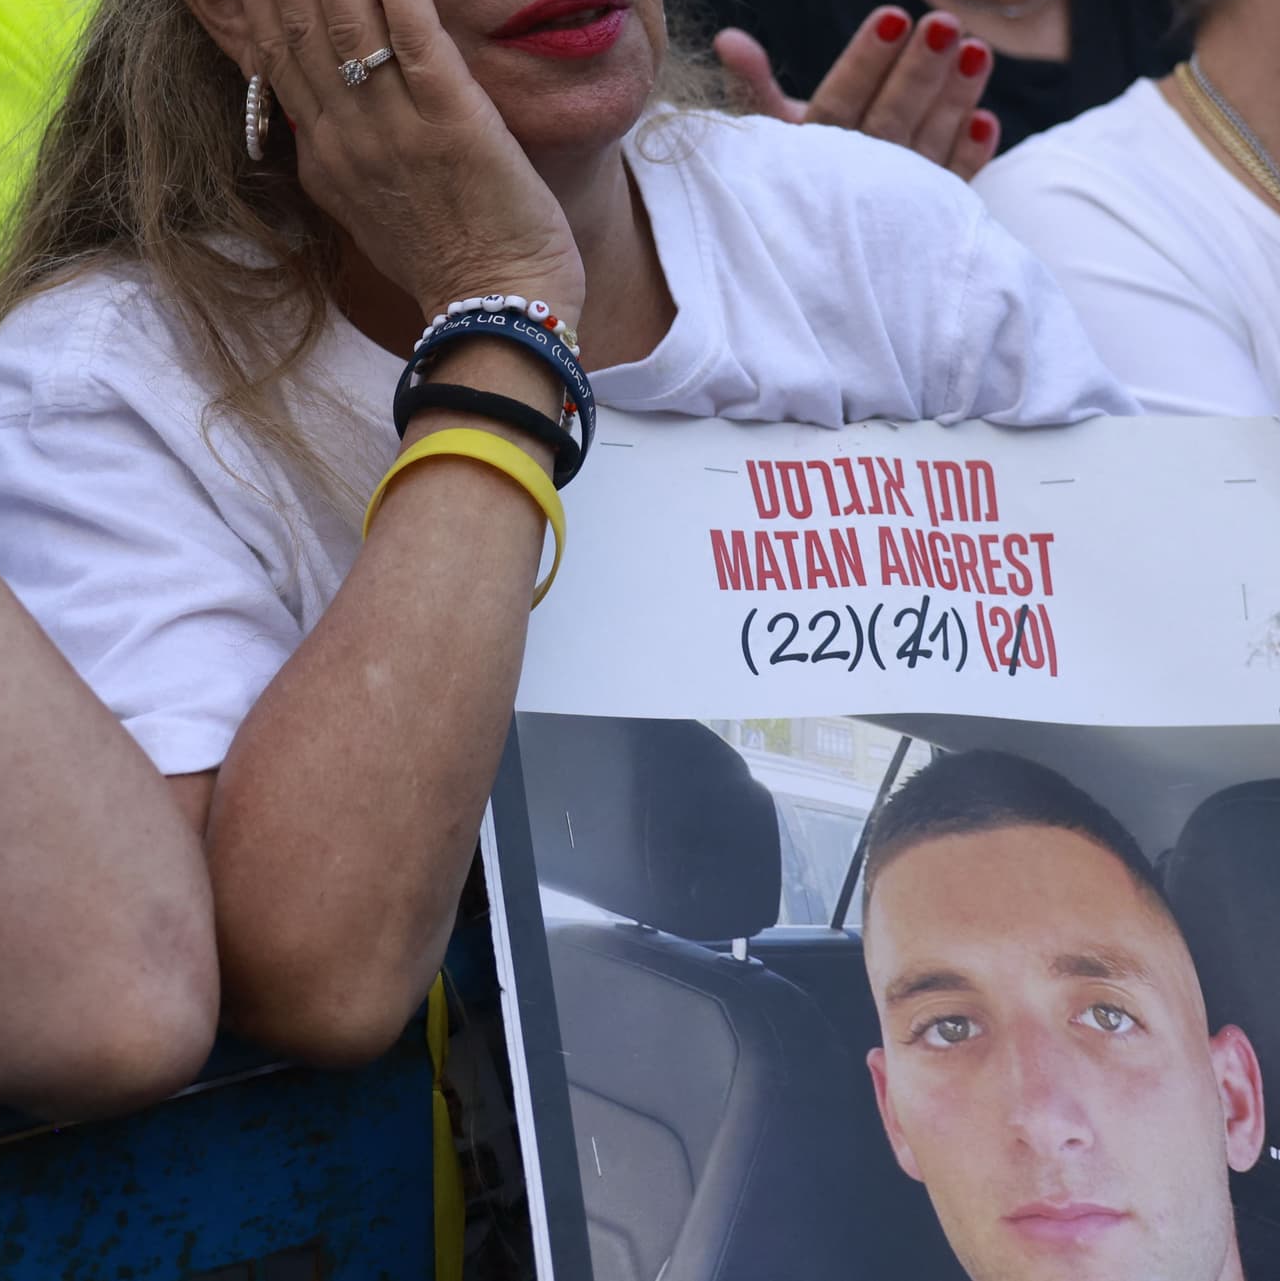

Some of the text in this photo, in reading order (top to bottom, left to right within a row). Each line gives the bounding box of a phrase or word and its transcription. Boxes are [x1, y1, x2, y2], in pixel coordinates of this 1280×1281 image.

[746, 456, 1000, 527] מתן אנגרסט
[710, 525, 1055, 597] MATAN ANGREST
